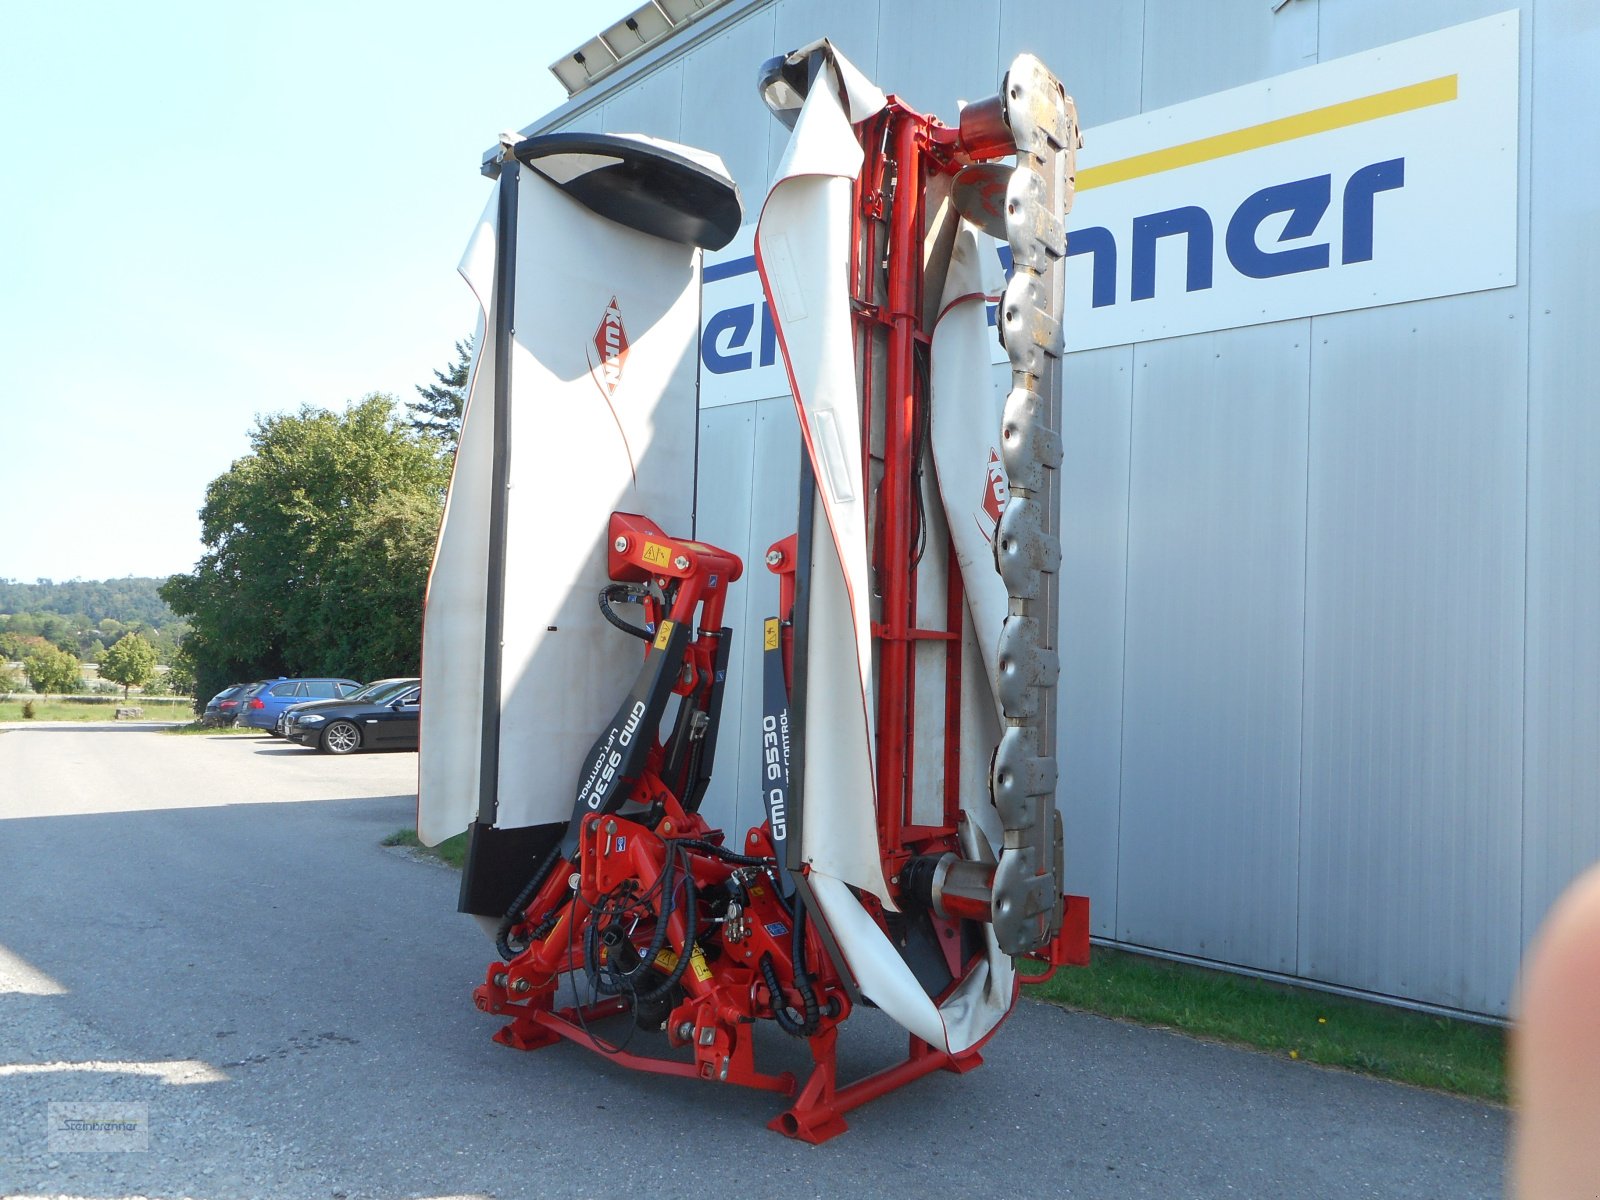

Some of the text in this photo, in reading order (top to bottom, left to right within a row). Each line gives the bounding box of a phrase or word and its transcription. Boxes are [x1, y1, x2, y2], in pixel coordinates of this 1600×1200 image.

[987, 157, 1405, 327] nner
[578, 727, 619, 801] LIFT CONTROL
[587, 700, 646, 810] GMD 9530
[763, 715, 787, 841] GMD 9530
